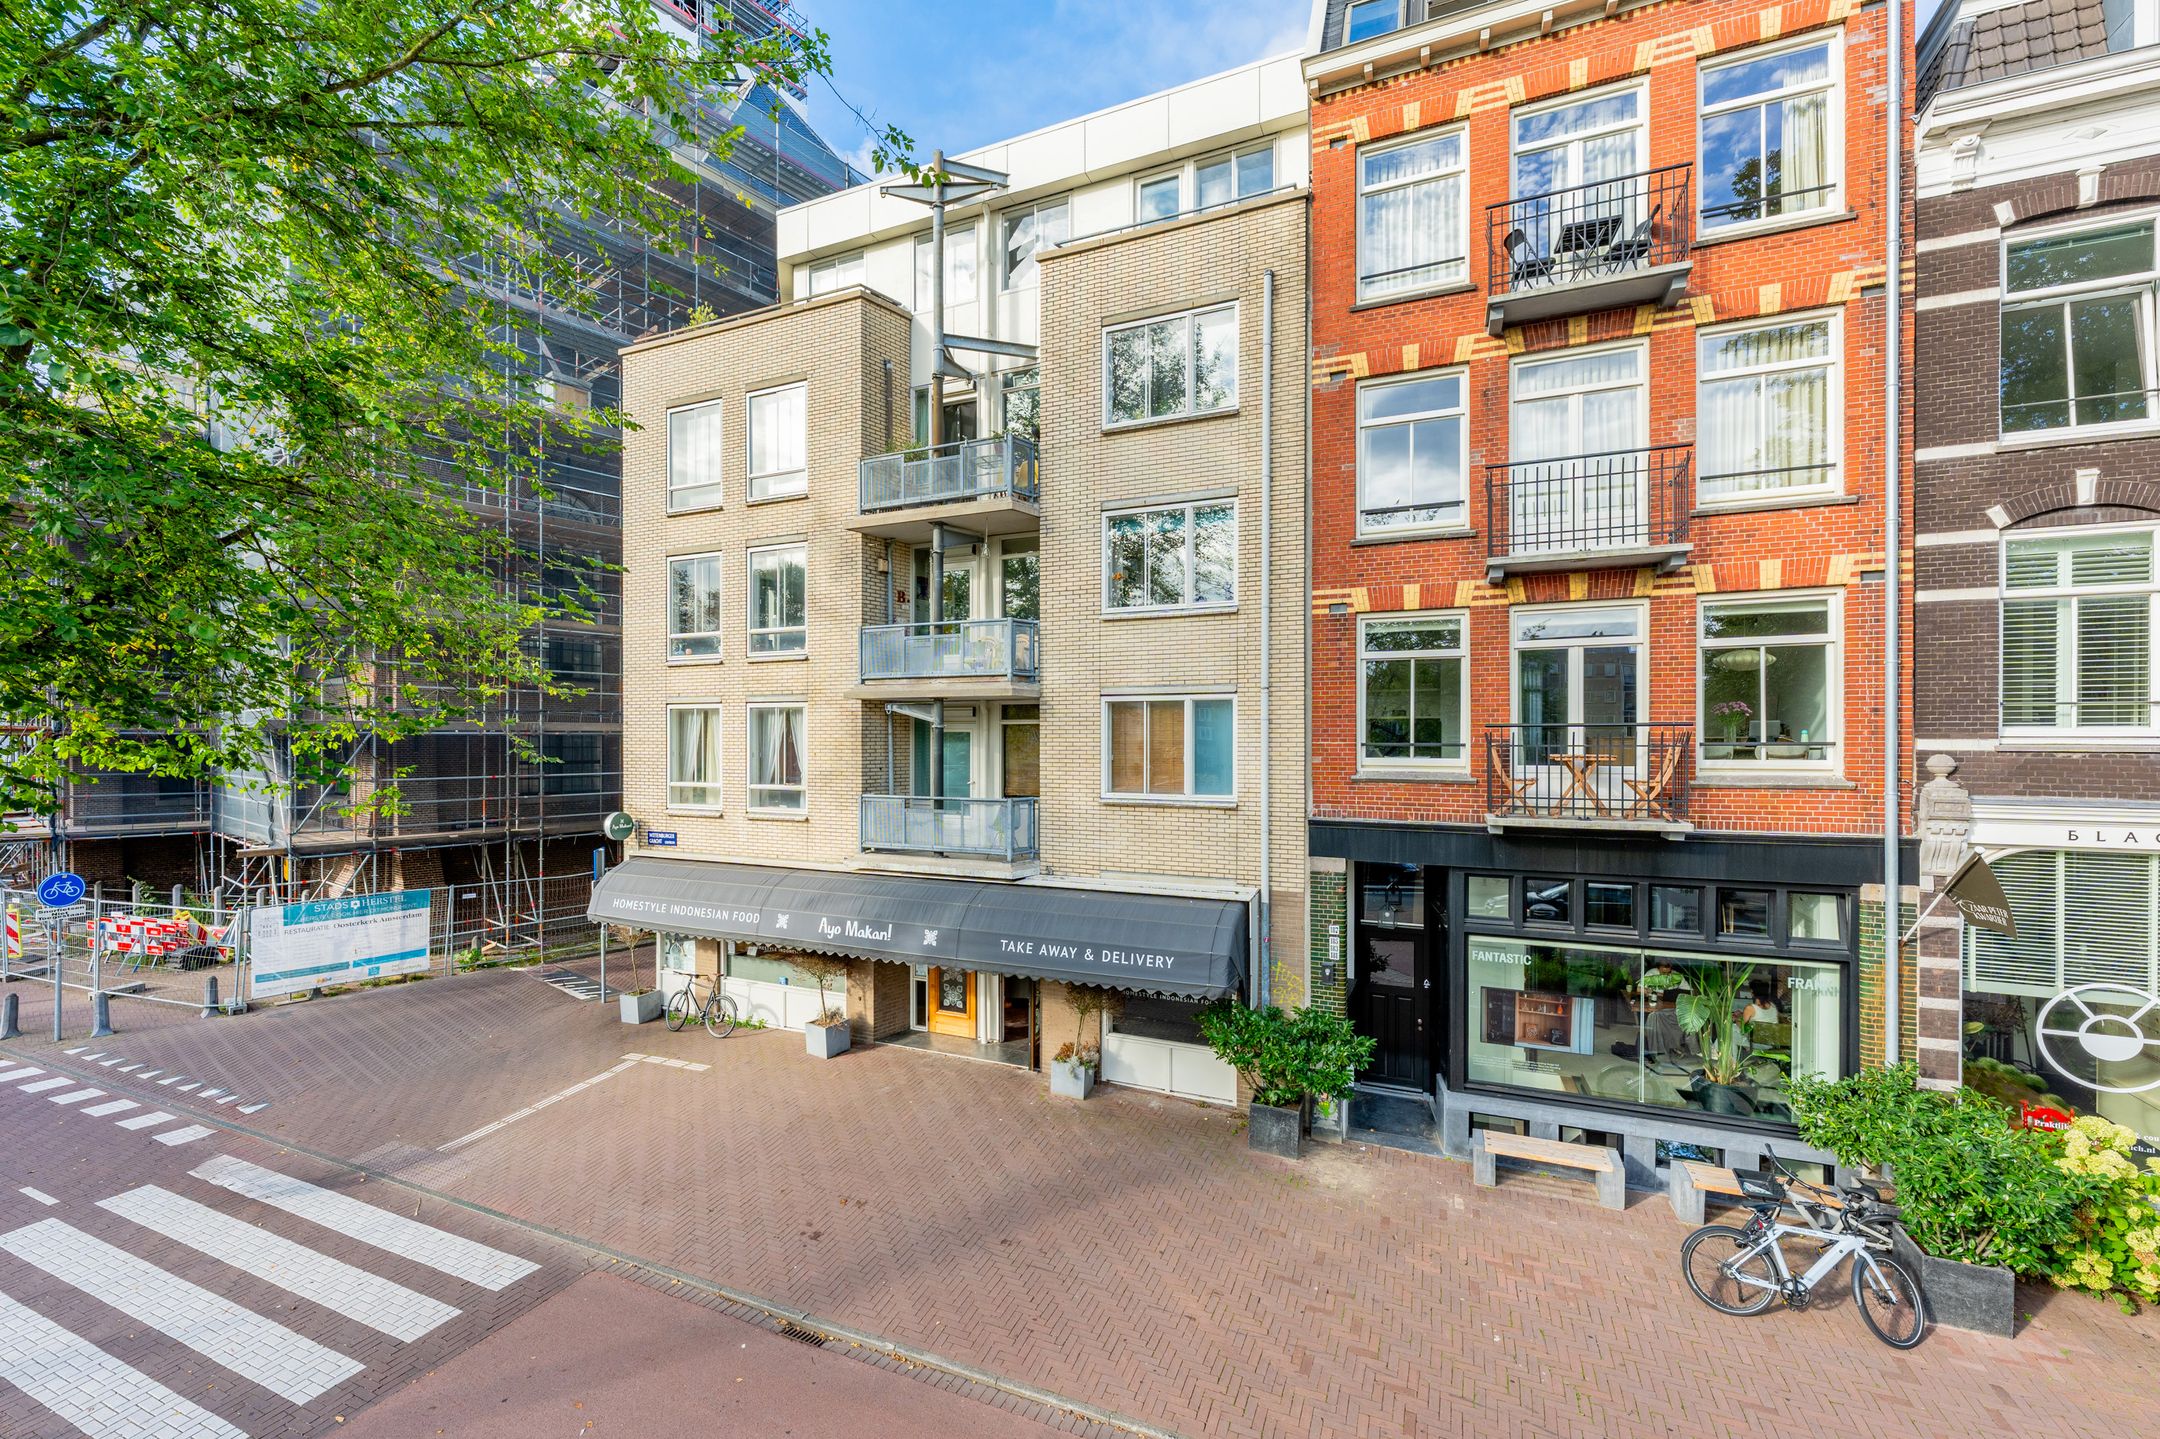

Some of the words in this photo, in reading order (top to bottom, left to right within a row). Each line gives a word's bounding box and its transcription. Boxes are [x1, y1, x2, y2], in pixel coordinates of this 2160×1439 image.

[314, 901, 349, 913] STADS
[362, 894, 406, 907] HERSTEL
[612, 898, 667, 913] HOMESTYLE
[670, 904, 729, 920] INDONESIAN
[732, 911, 760, 924] FOOD
[284, 924, 330, 936] RESTAURATIE
[333, 917, 378, 929] Oosterkerk
[380, 912, 422, 922] Amsterdam
[818, 917, 841, 939] Ayo
[845, 920, 893, 941] Makan!
[1000, 939, 1034, 954] TAKE
[1039, 943, 1078, 959] AWAY
[1084, 948, 1094, 961] &
[1102, 950, 1175, 969] DELIVERY
[1472, 950, 1532, 966] FANTASTIC
[1159, 994, 1199, 1004] INDONESIAN
[2034, 1119, 2070, 1130] Praktijk
